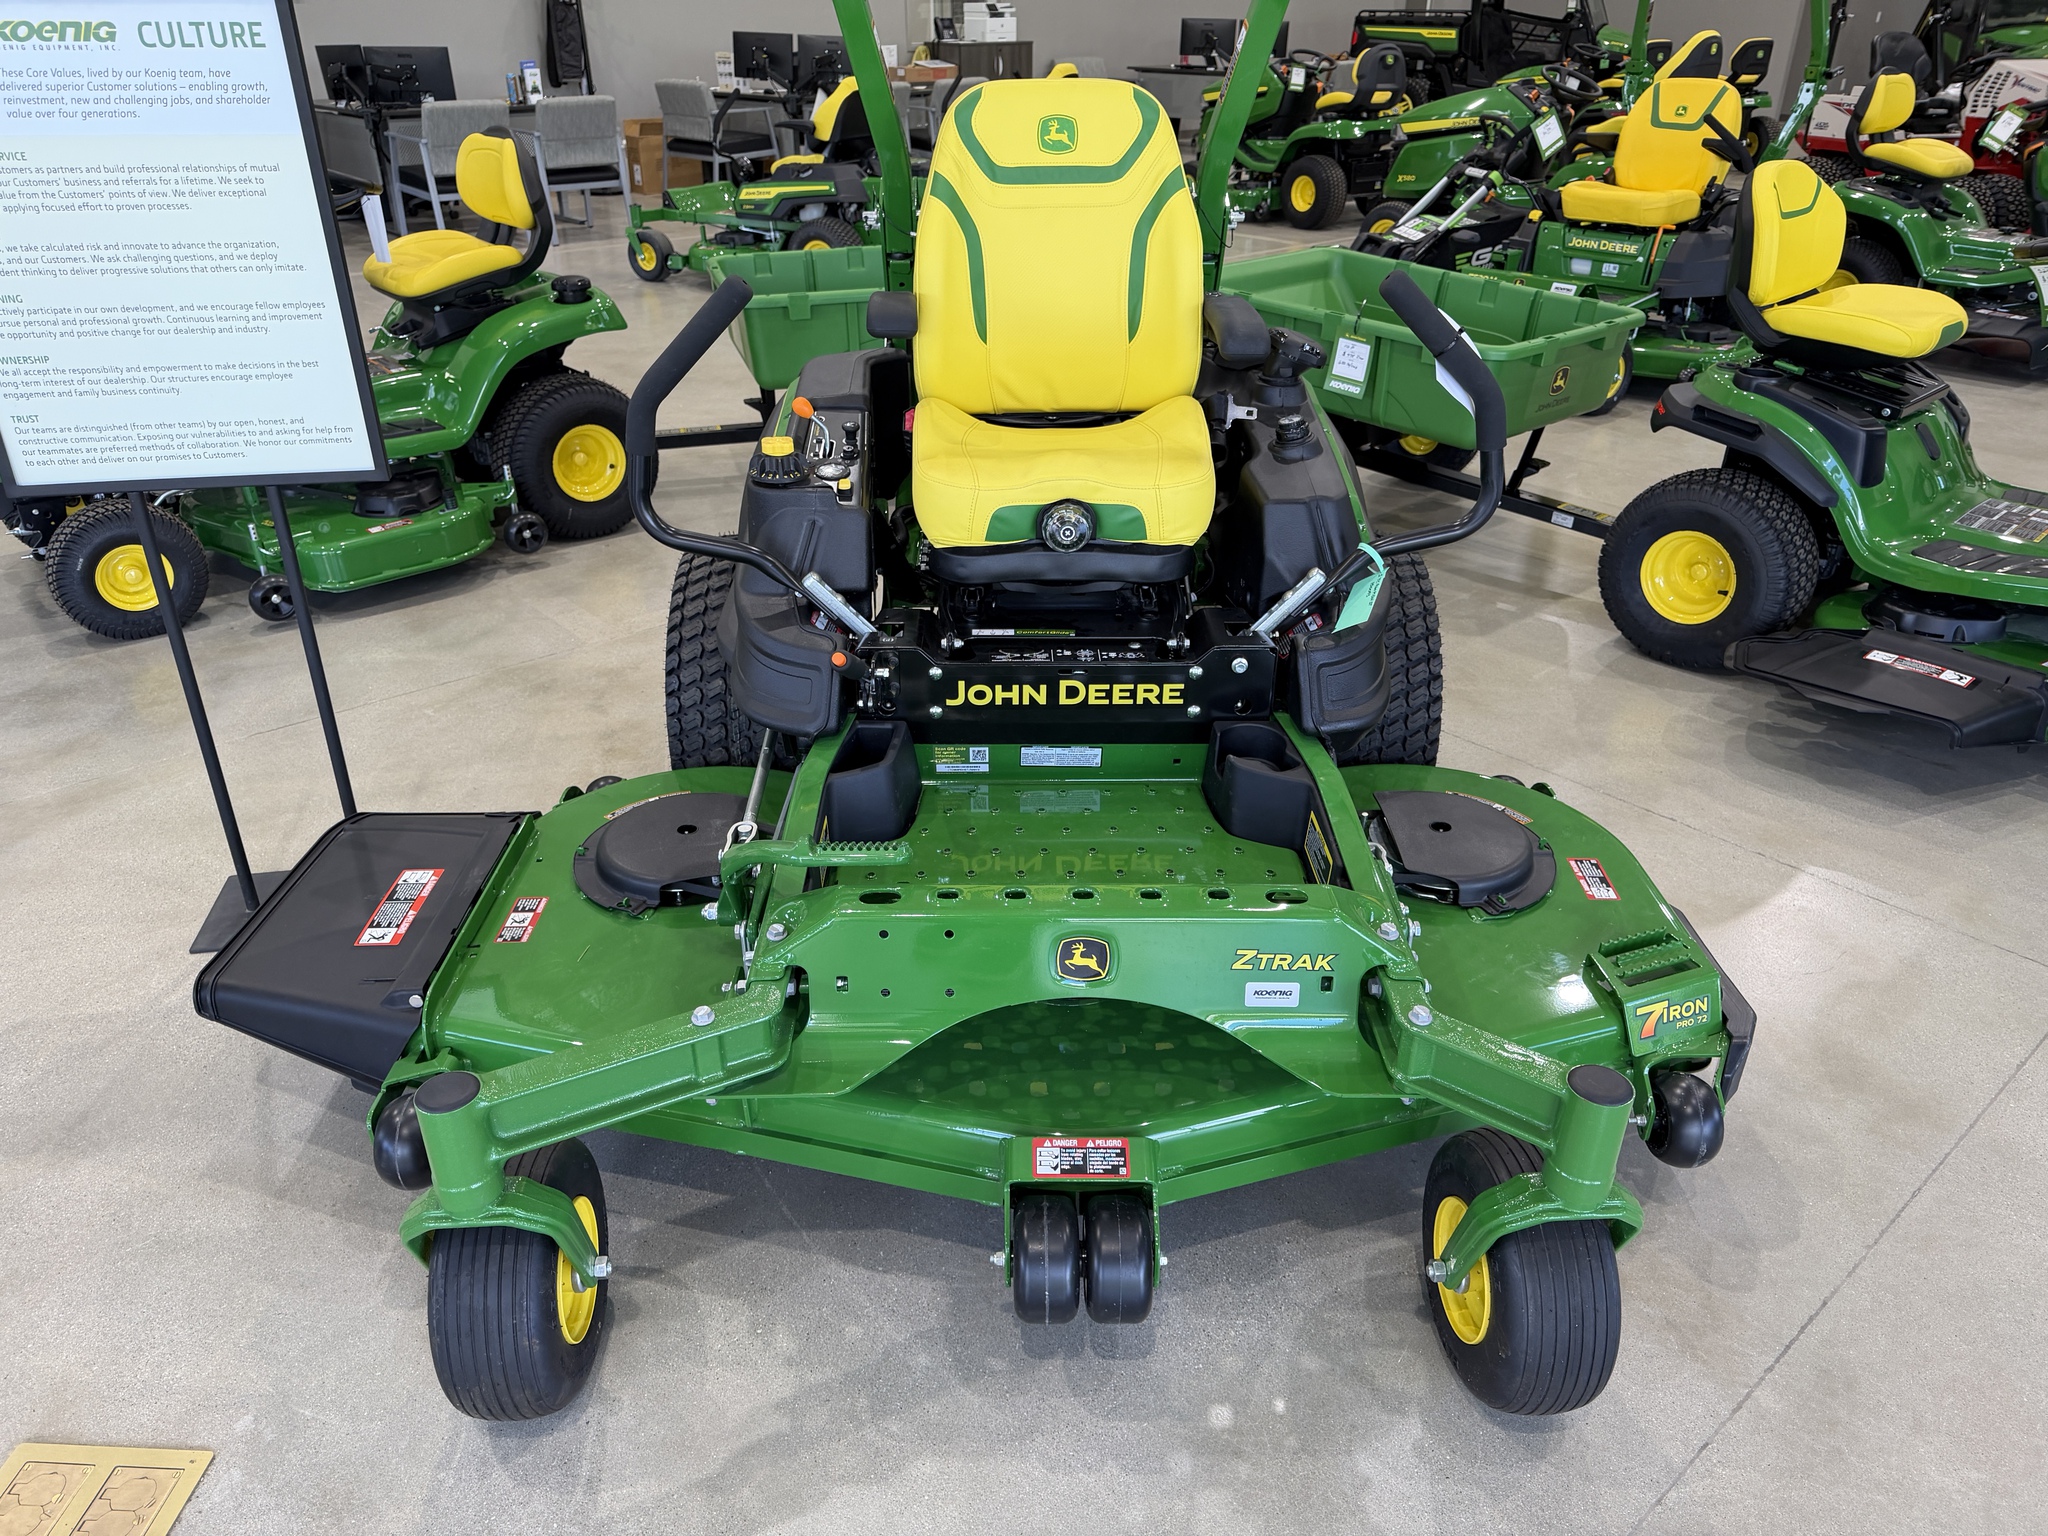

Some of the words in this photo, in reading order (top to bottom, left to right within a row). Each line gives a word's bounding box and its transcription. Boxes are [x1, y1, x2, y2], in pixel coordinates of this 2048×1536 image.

[137, 21, 266, 48] CULTURE
[26, 68, 48, 77] Core
[50, 68, 84, 78] Values,
[87, 68, 109, 77] lived
[112, 68, 123, 80] by
[145, 68, 176, 80] Koenig
[179, 68, 206, 79] team,
[209, 68, 230, 77] have
[0, 82, 42, 91] delivered
[45, 82, 84, 93] superior
[87, 82, 132, 91] Customer
[134, 81, 178, 91] solutions
[188, 81, 228, 93] enabling
[231, 81, 268, 93] growth,
[3, 96, 68, 106] reinvestment,
[93, 95, 111, 104] and
[114, 95, 168, 107] challenging
[170, 95, 192, 107] jobs,
[195, 95, 213, 104] and
[216, 95, 270, 104] shareholder
[7, 109, 32, 118] value
[58, 108, 78, 118] four
[81, 109, 140, 120] generations.
[46, 165, 83, 176] partners
[85, 164, 102, 173] and
[103, 164, 126, 173] build
[127, 164, 180, 175] professional
[182, 163, 237, 174] relationships
[239, 163, 247, 172] of
[250, 163, 280, 172] mutual
[13, 178, 61, 187] Customers'
[63, 177, 102, 186] business
[103, 177, 120, 186] and
[121, 177, 158, 186] referrals
[159, 176, 172, 185] for
[180, 176, 216, 185] lifetime.
[217, 176, 232, 184] We
[234, 176, 254, 184] seek
[255, 176, 264, 184] to
[18, 190, 40, 199] from
[41, 190, 56, 199] the
[57, 190, 105, 199] Customers'
[108, 190, 136, 200] points
[137, 189, 146, 198] of
[148, 190, 171, 198] view.
[171, 189, 186, 198] We
[188, 188, 216, 197] deliver
[218, 188, 267, 199] exceptional
[3, 203, 40, 214] applying
[41, 202, 76, 211] focused
[78, 202, 103, 211] effort
[104, 202, 114, 211] to
[116, 204, 146, 212] proven
[147, 203, 192, 212] processes.
[20, 243, 39, 252] take
[41, 242, 85, 252] calculated
[86, 242, 102, 251] risk
[104, 242, 120, 250] and
[121, 242, 158, 250] innovate
[160, 242, 170, 250] to
[172, 240, 206, 249] advance
[208, 240, 222, 249] the
[224, 240, 279, 251] organization,
[1568, 237, 1598, 249] JOHN
[1600, 240, 1639, 254] DEERE
[21, 267, 57, 278] thinking
[58, 267, 68, 275] to
[70, 266, 98, 275] deliver
[100, 266, 148, 277] progressive
[150, 264, 189, 274] solutions
[190, 264, 209, 273] that
[210, 264, 237, 272] others
[255, 263, 273, 274] only
[274, 263, 306, 271] imitate.
[7, 329, 57, 341] opportunity
[59, 328, 75, 337] and
[76, 328, 109, 339] positive
[111, 327, 141, 338] change
[143, 326, 155, 335] for
[173, 325, 216, 336] dealership
[218, 324, 233, 333] and
[234, 323, 270, 335] industry.
[3, 389, 56, 401] engagement
[57, 388, 73, 397] and
[74, 387, 100, 399] family
[100, 386, 137, 396] business
[138, 385, 182, 397] continuity.
[10, 414, 39, 424] TRUST
[14, 426, 30, 434] Our
[31, 425, 58, 434] teams
[74, 422, 129, 434] distinguished
[130, 421, 153, 432] (from
[154, 420, 176, 429] other
[178, 419, 206, 430] teams)
[207, 419, 216, 430] by
[234, 420, 257, 428] open,
[258, 416, 288, 427] honest,
[290, 415, 304, 424] and
[25, 458, 35, 466] to
[36, 457, 56, 466] each
[57, 456, 79, 465] other
[82, 455, 97, 464] and
[98, 454, 124, 463] deliver
[155, 452, 192, 463] promises
[192, 451, 202, 459] to
[203, 449, 247, 459] Customers.
[946, 680, 1047, 706] JOHN
[1058, 680, 1185, 705] DEERE
[1231, 949, 1338, 971] ZTRAK
[1676, 1019, 1694, 1030] PRO
[1697, 1015, 1707, 1024] 72
